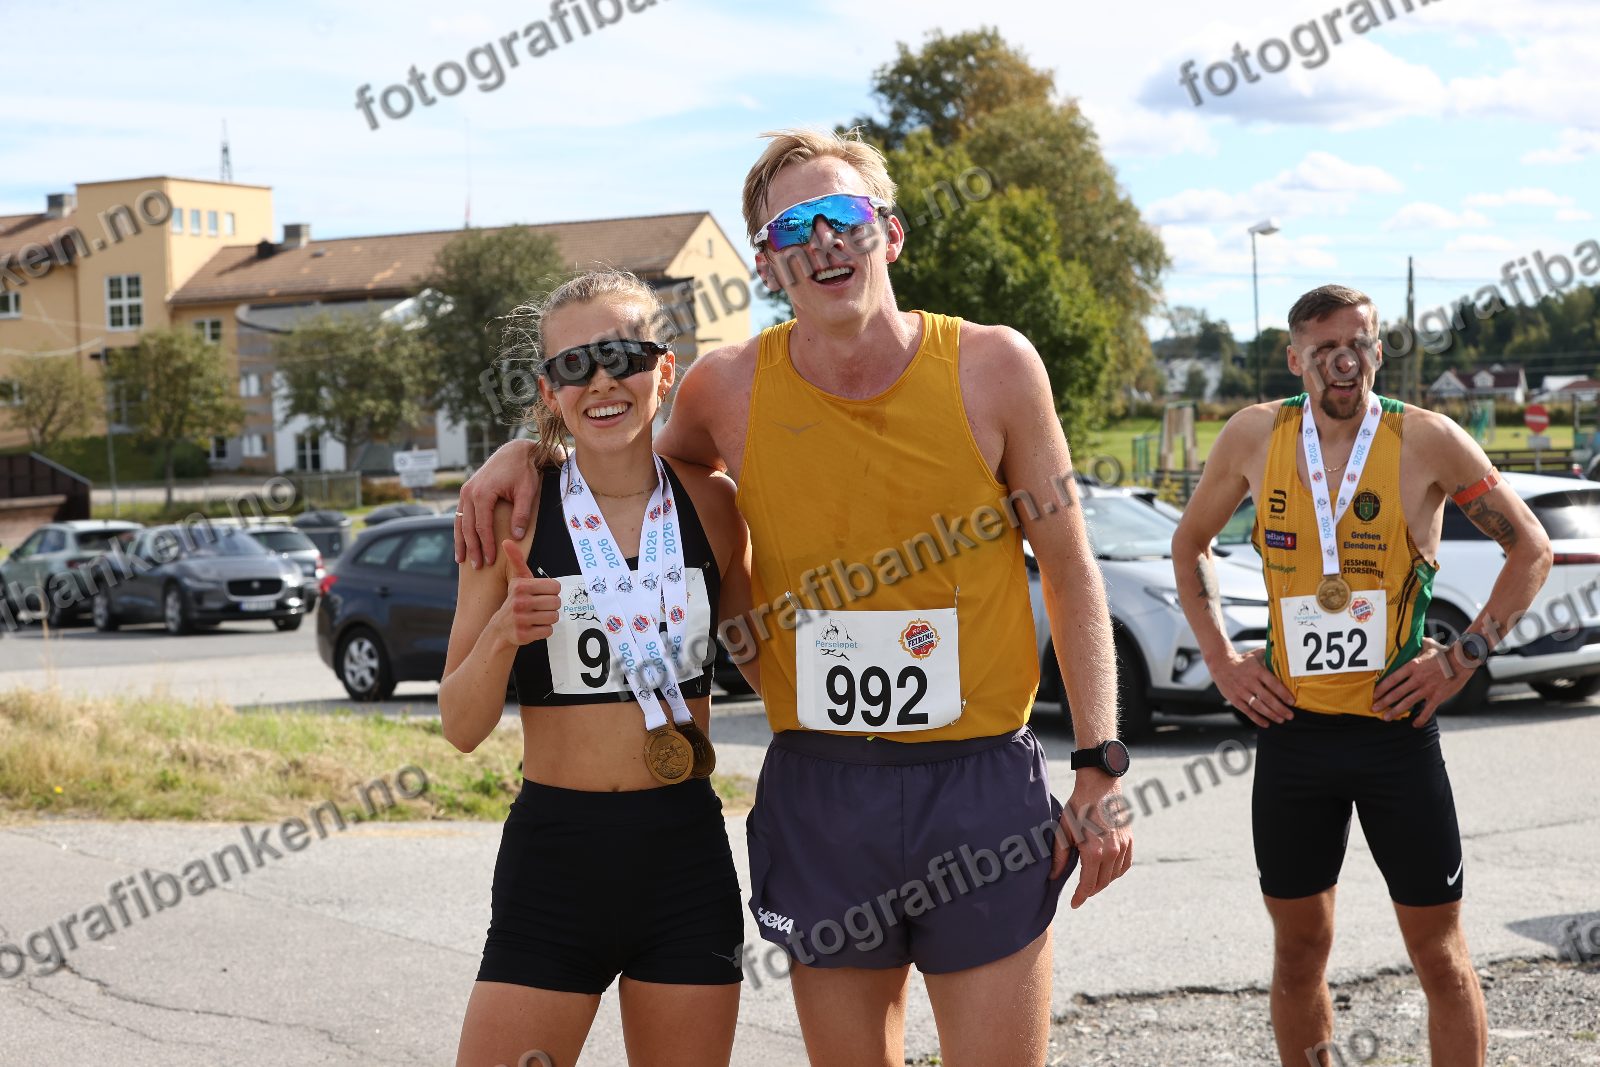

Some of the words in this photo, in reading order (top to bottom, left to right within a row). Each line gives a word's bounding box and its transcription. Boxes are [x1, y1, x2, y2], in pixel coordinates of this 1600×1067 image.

[645, 530, 658, 563] 2026
[663, 521, 677, 555] 2026
[1351, 531, 1380, 540] Grefsen
[578, 538, 598, 569] 2026
[597, 538, 621, 569] 2026
[1344, 559, 1376, 567] JESSHEIM
[815, 640, 858, 650] Perseløpet
[907, 632, 934, 648] FEIRING
[1303, 628, 1368, 671] 252
[618, 642, 640, 676] 2026
[645, 640, 668, 674] 2026
[825, 664, 929, 727] 992
[757, 906, 794, 934] HOKA
